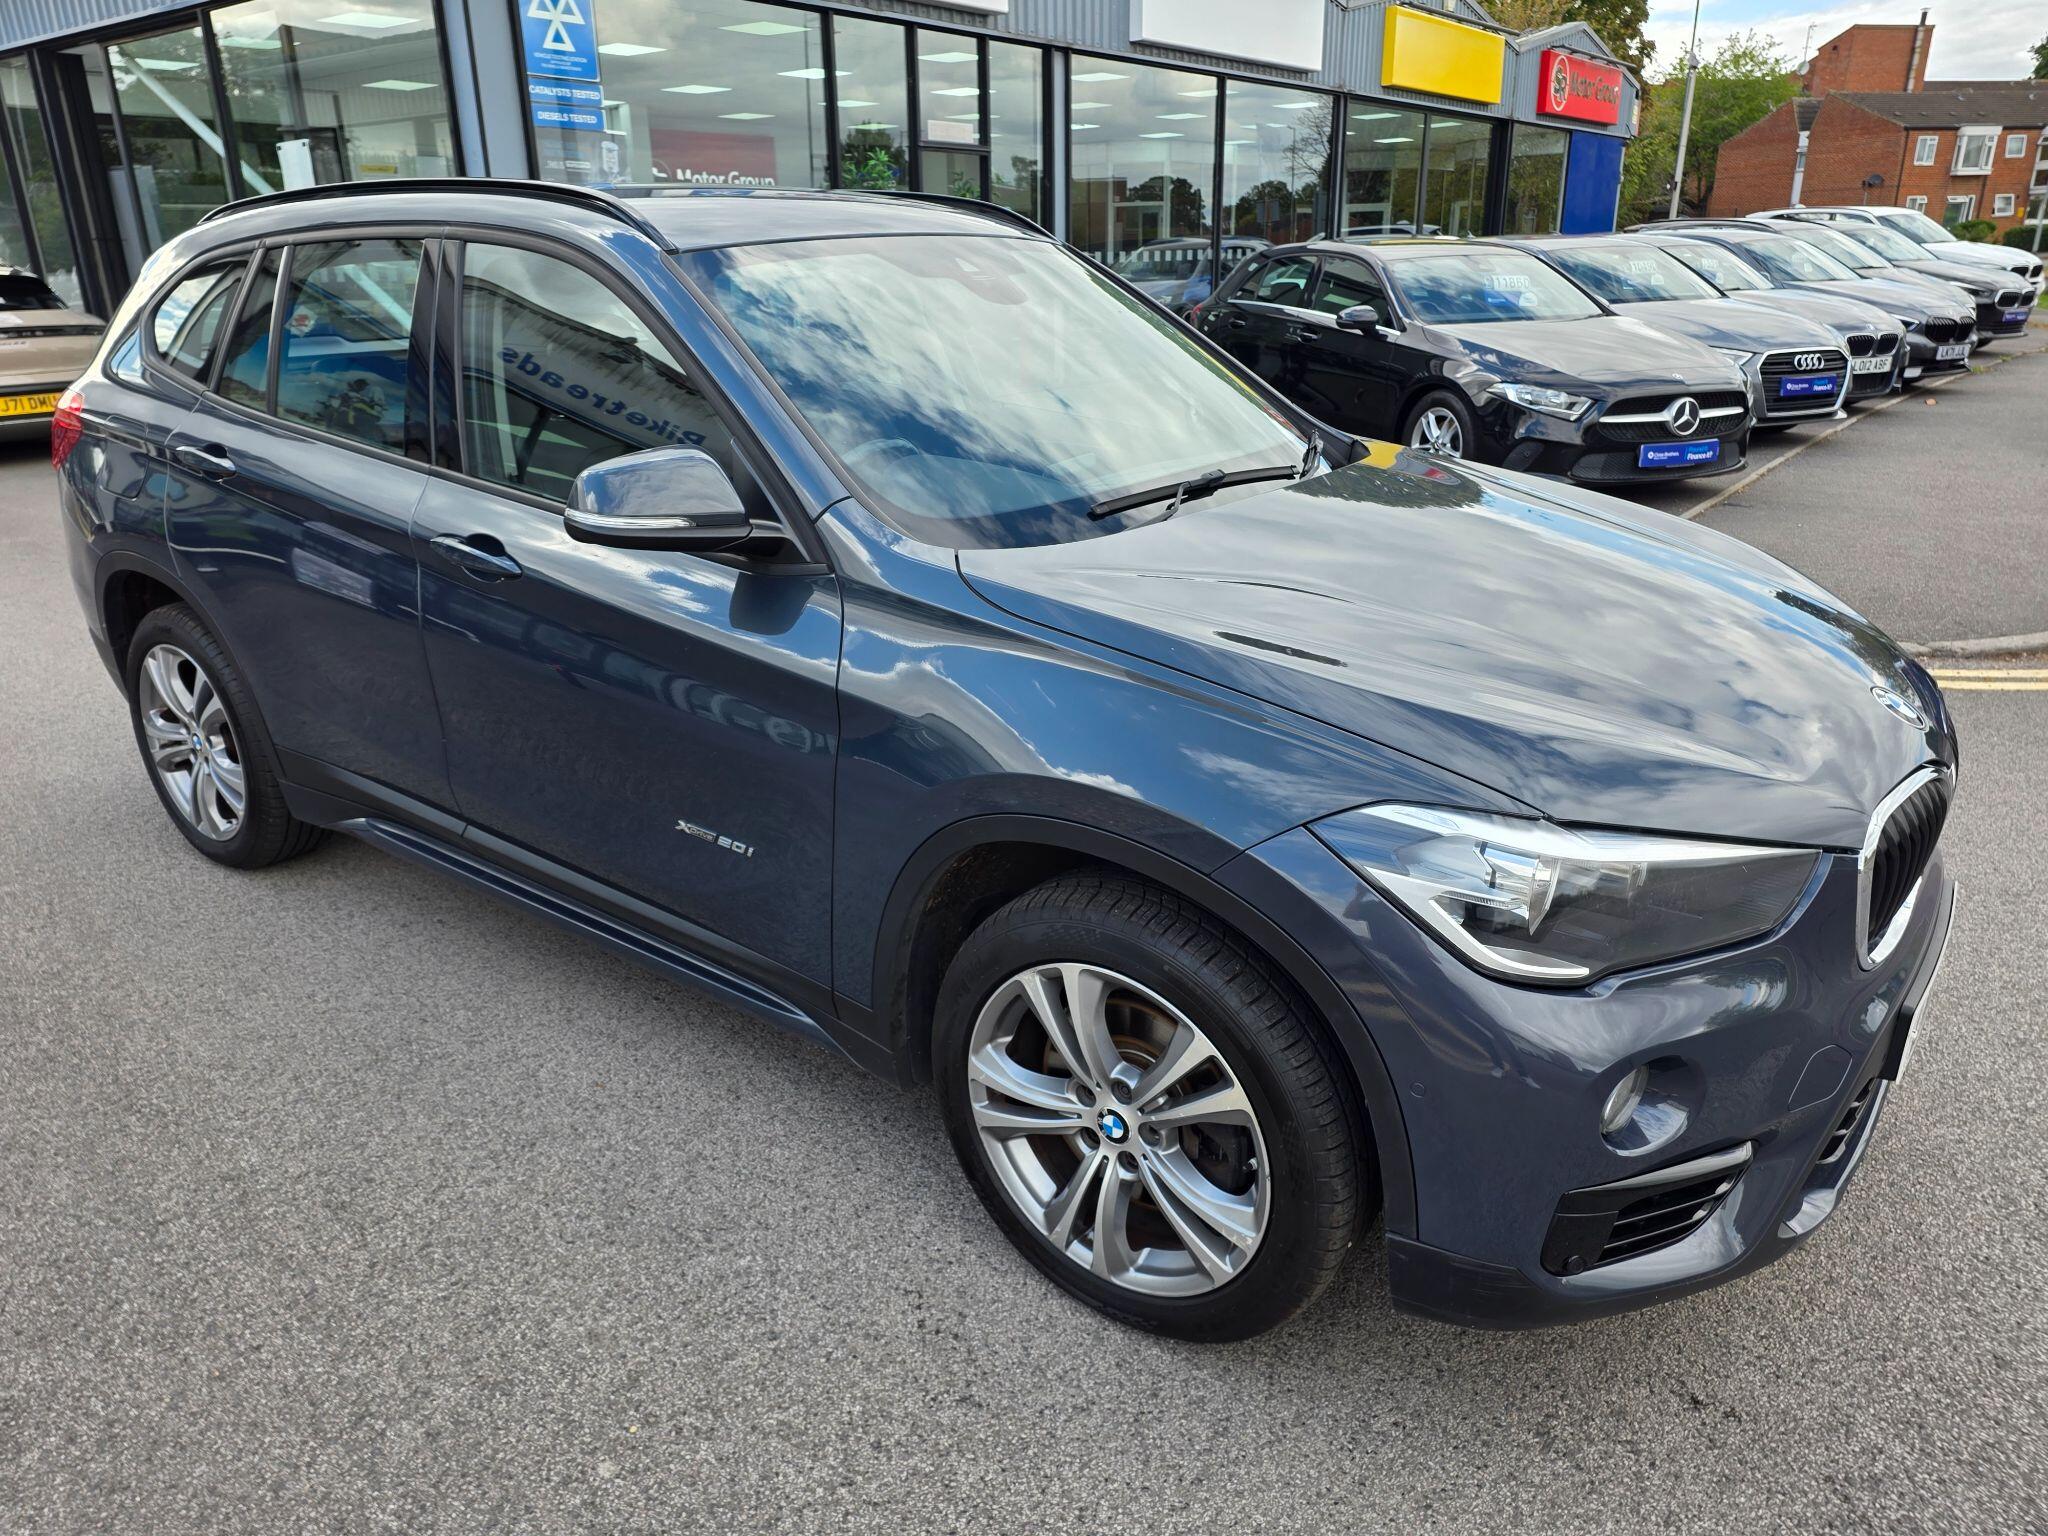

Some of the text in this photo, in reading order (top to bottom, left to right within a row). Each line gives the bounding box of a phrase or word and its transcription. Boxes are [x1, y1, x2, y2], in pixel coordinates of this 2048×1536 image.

[572, 89, 601, 100] TESTED
[537, 111, 598, 124] DIESELS TESTED
